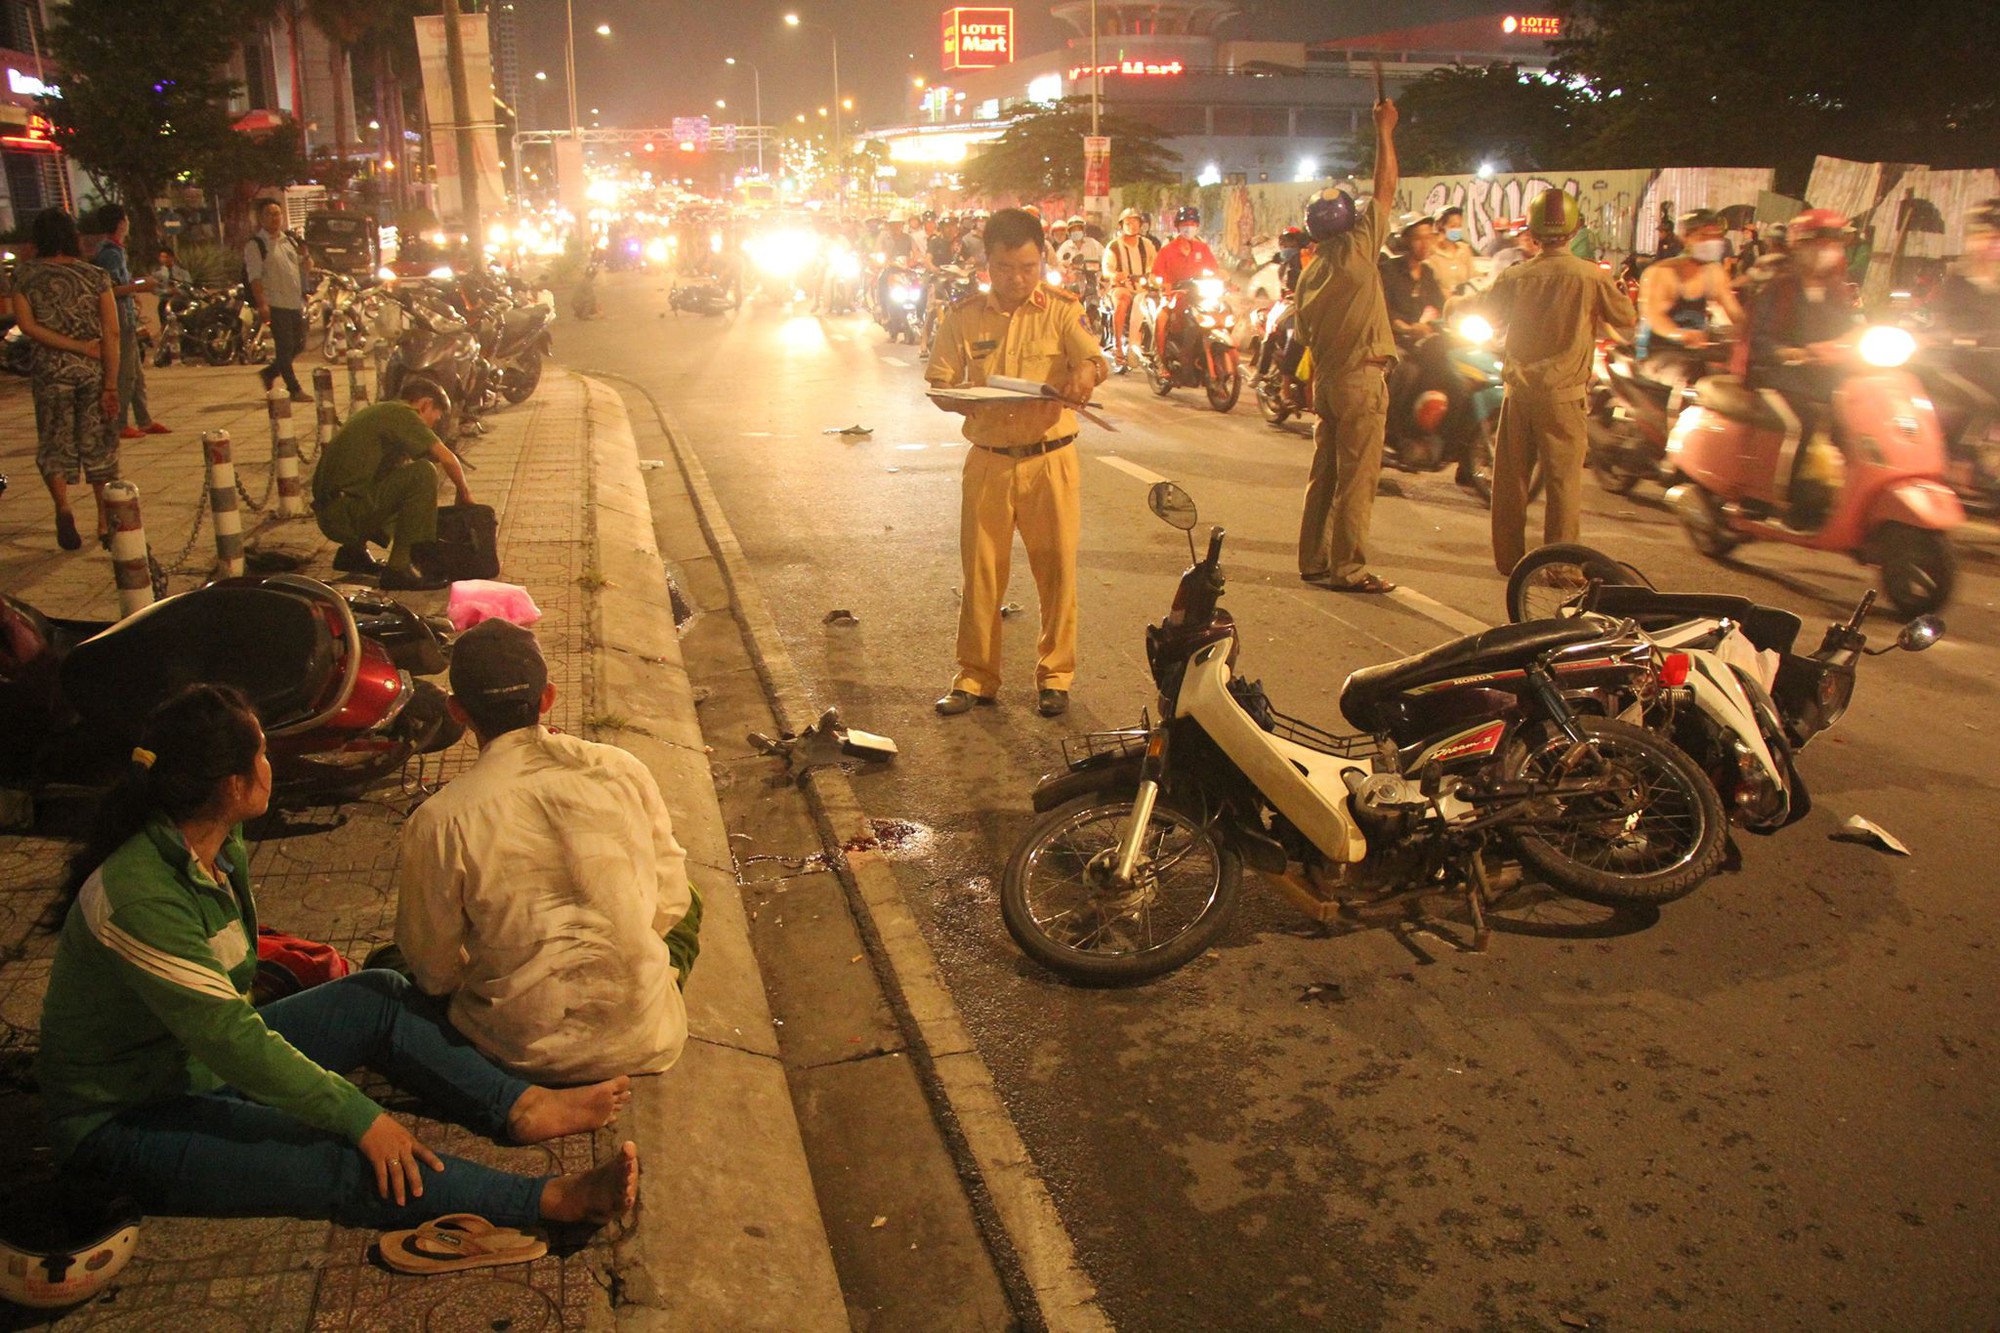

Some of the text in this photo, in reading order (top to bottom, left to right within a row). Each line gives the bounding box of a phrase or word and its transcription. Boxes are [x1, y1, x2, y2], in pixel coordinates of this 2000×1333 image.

[1521, 17, 1559, 27] LOTTE
[961, 24, 1006, 35] LOTTE
[962, 36, 1007, 52] Mart
[1121, 61, 1183, 75] Mart
[1453, 674, 1494, 686] HONDA
[1429, 741, 1481, 760] Dream
